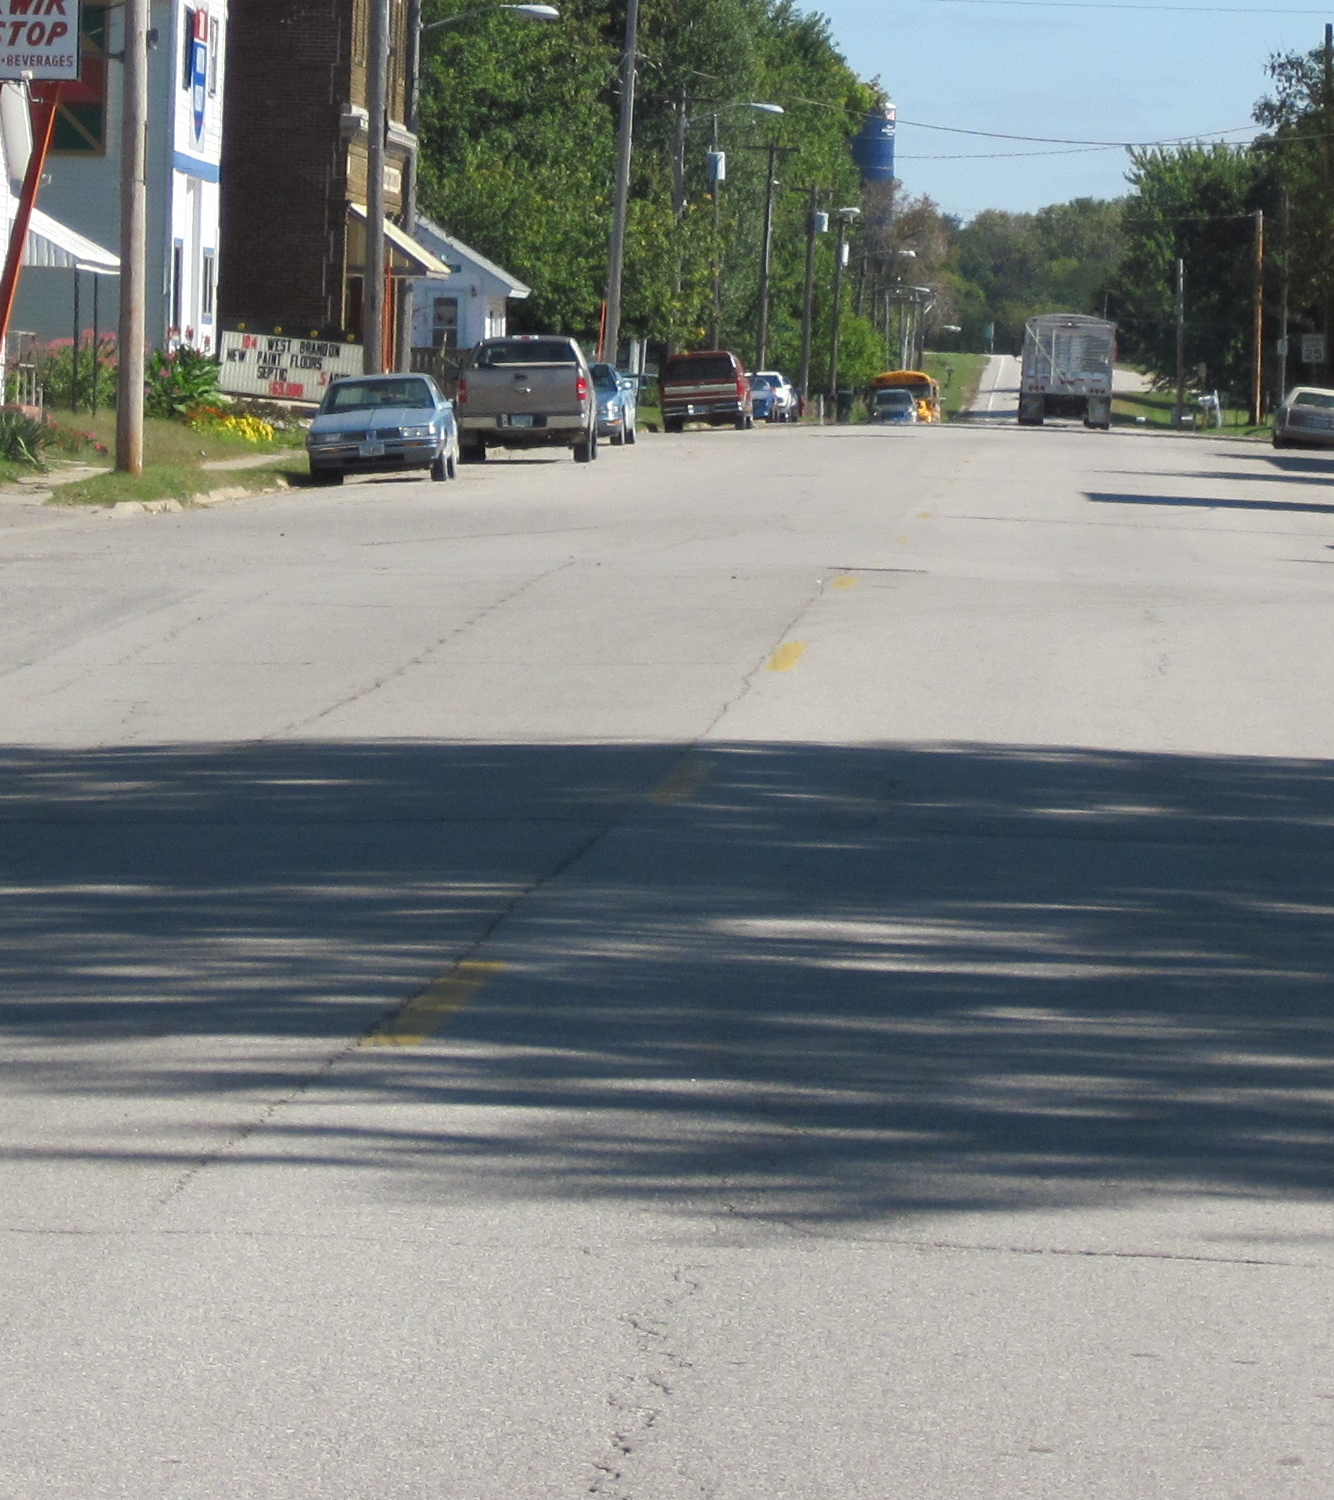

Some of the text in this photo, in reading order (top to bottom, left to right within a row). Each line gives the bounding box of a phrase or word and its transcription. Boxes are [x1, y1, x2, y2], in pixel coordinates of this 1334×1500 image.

[299, 340, 340, 358] BRANDON
[226, 349, 322, 370] NEW PAINT FLOORS
[257, 365, 288, 382] SEPTIC
